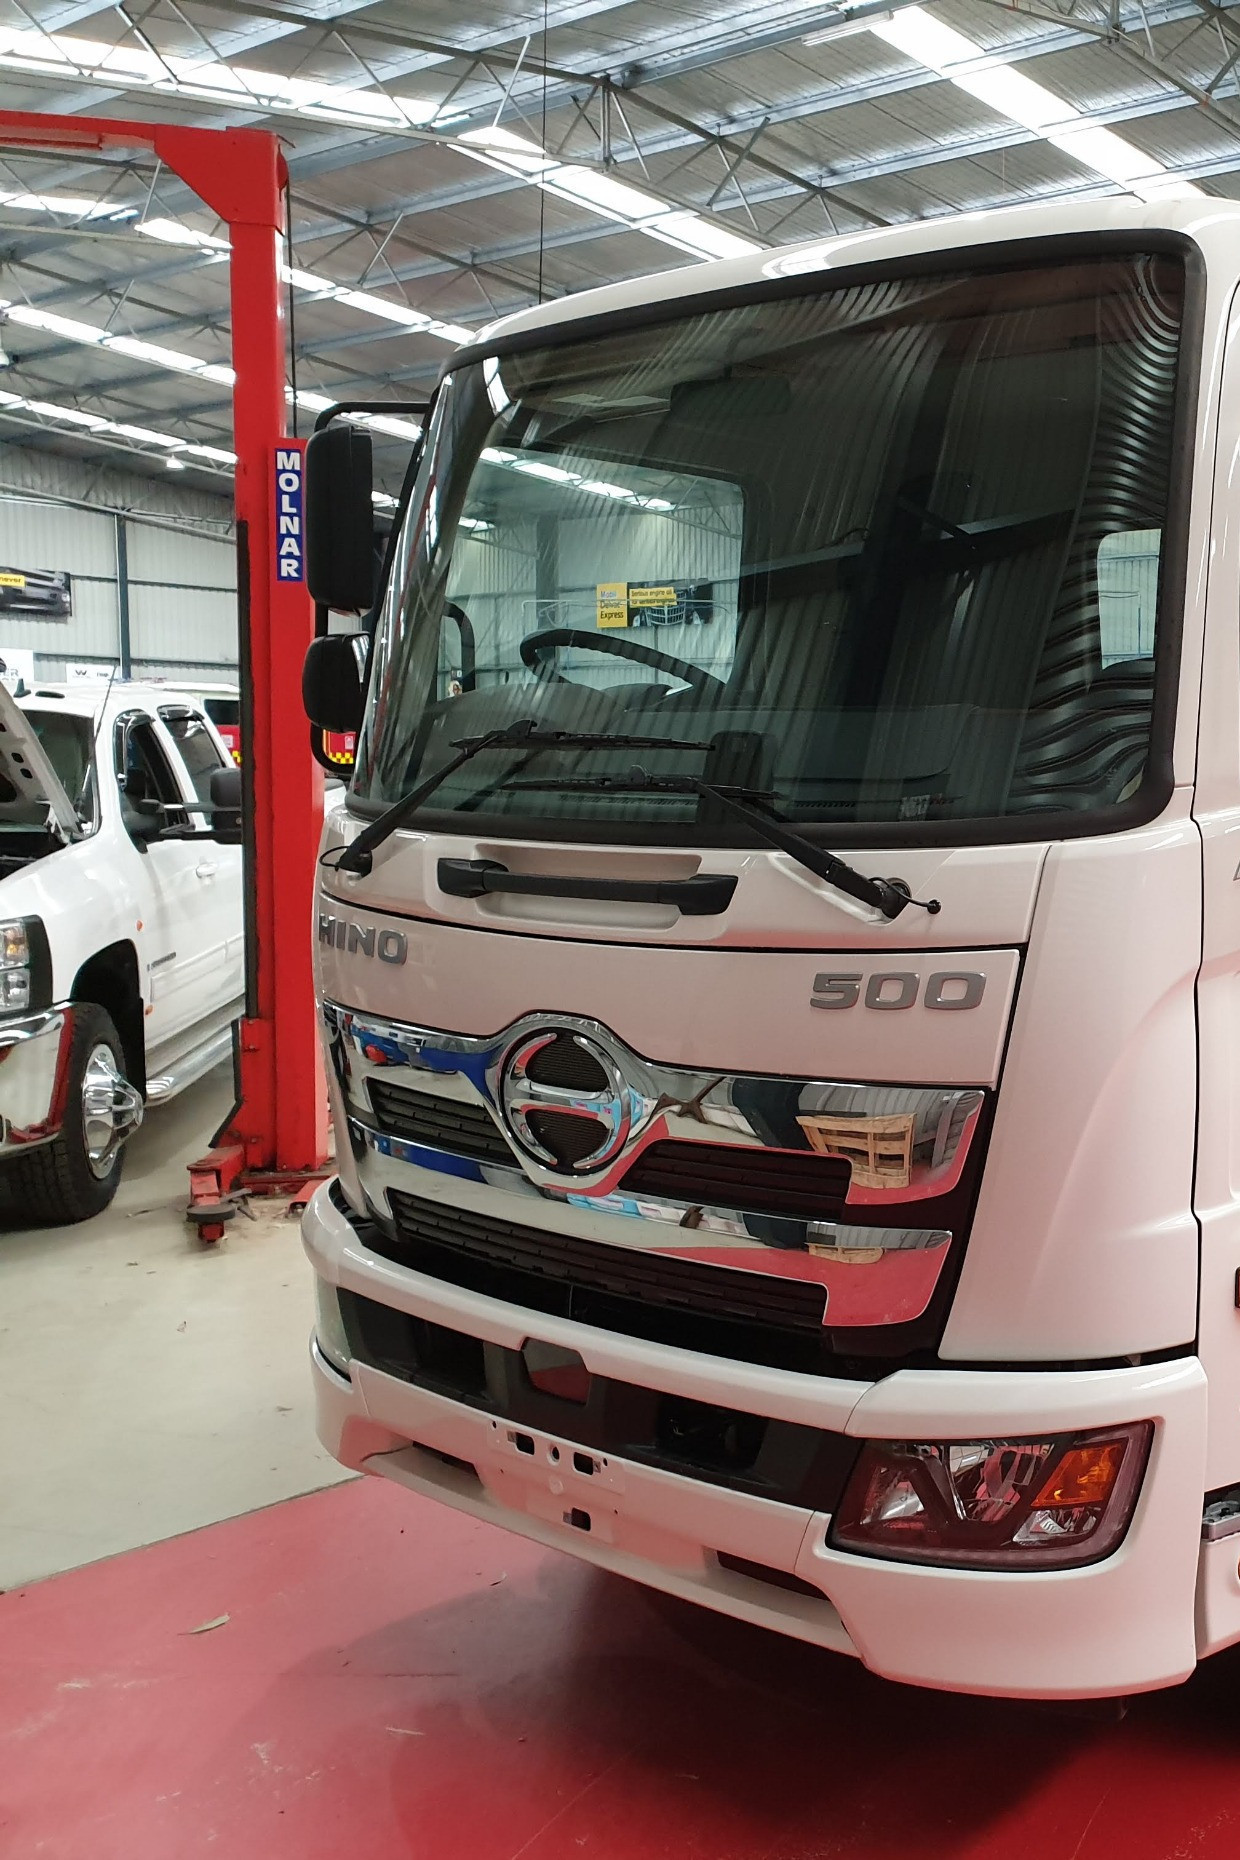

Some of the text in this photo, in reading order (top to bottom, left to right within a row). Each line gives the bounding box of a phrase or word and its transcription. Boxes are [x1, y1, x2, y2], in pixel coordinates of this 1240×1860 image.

[276, 451, 300, 577] MOLNAR
[601, 611, 624, 620] Express
[319, 913, 408, 966] HINO
[809, 972, 988, 1010] 500
